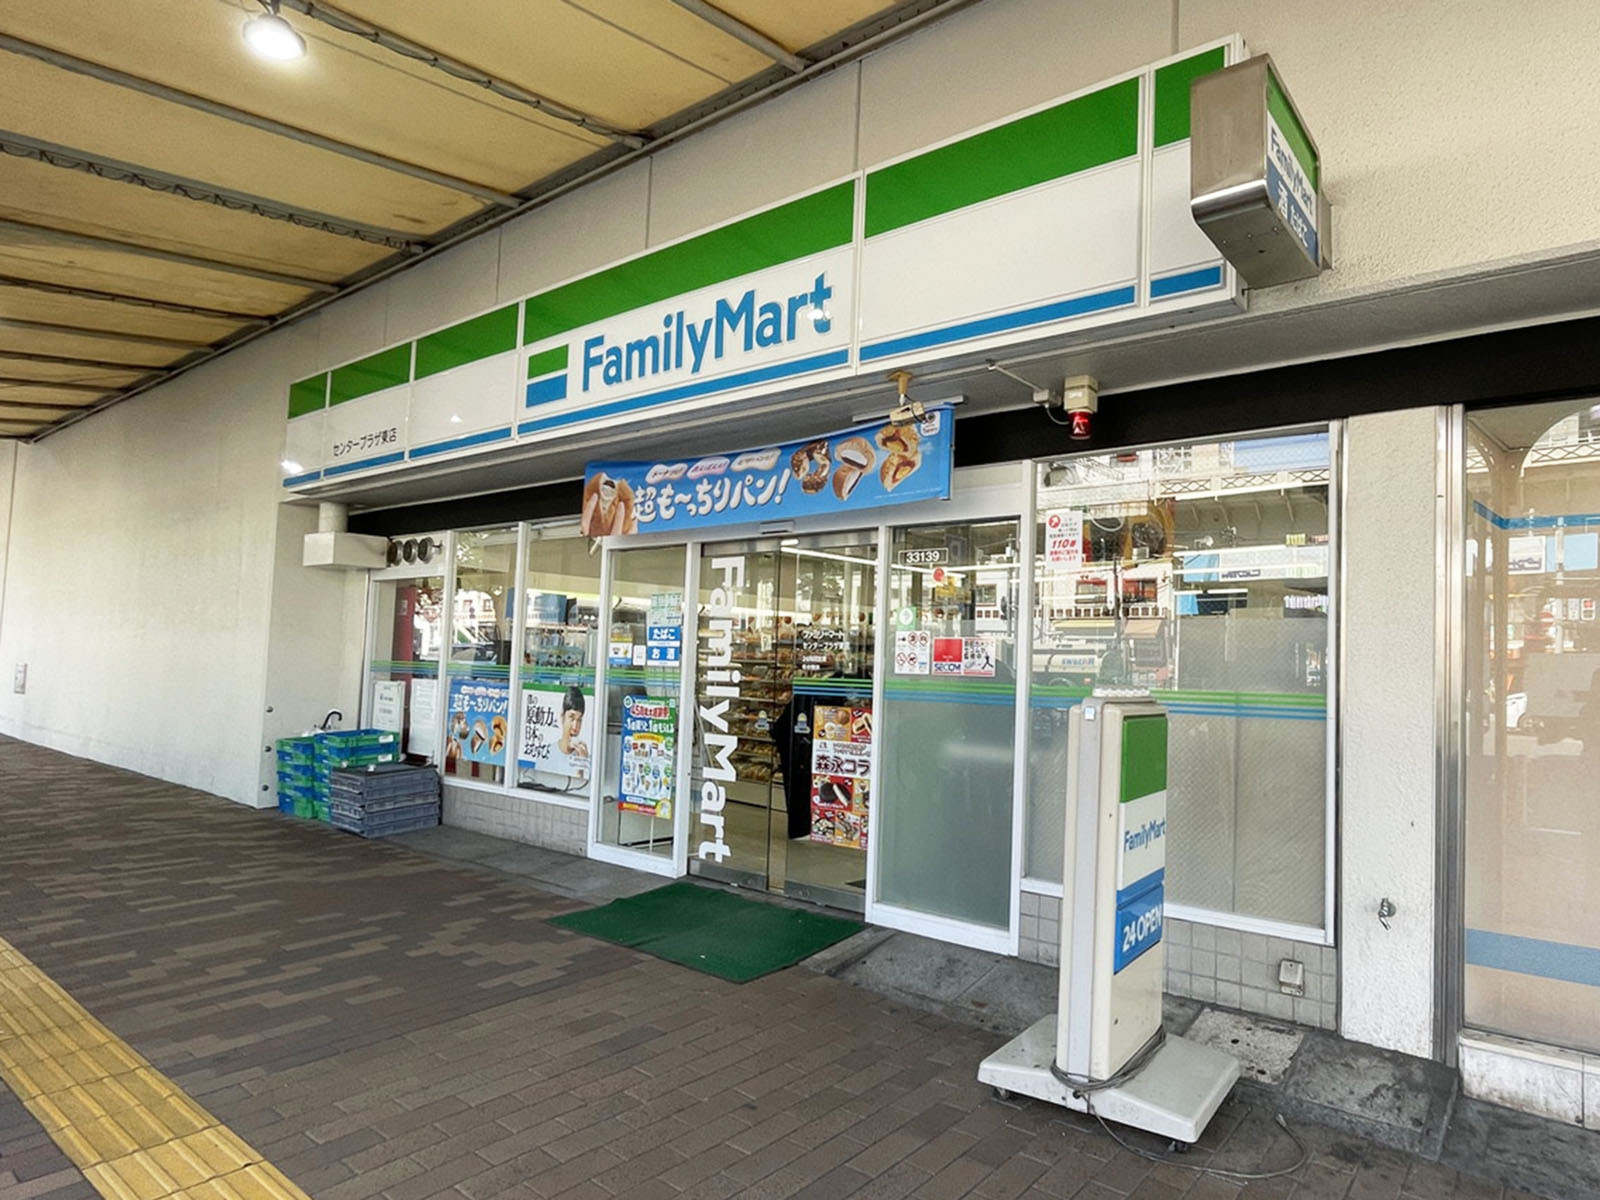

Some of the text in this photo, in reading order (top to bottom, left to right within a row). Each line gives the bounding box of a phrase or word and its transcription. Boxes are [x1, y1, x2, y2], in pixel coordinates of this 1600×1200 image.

[1270, 126, 1313, 216] FamilyMart
[582, 271, 833, 392] FamilyMart
[333, 427, 397, 457] センタープラザ東店
[905, 550, 940, 563] 33139
[652, 627, 676, 640] たばこ
[934, 663, 961, 672] SECOM
[698, 556, 745, 863] FamilyMart
[1123, 817, 1167, 853] FamilyMart
[1121, 903, 1163, 953] 24 OPEN
